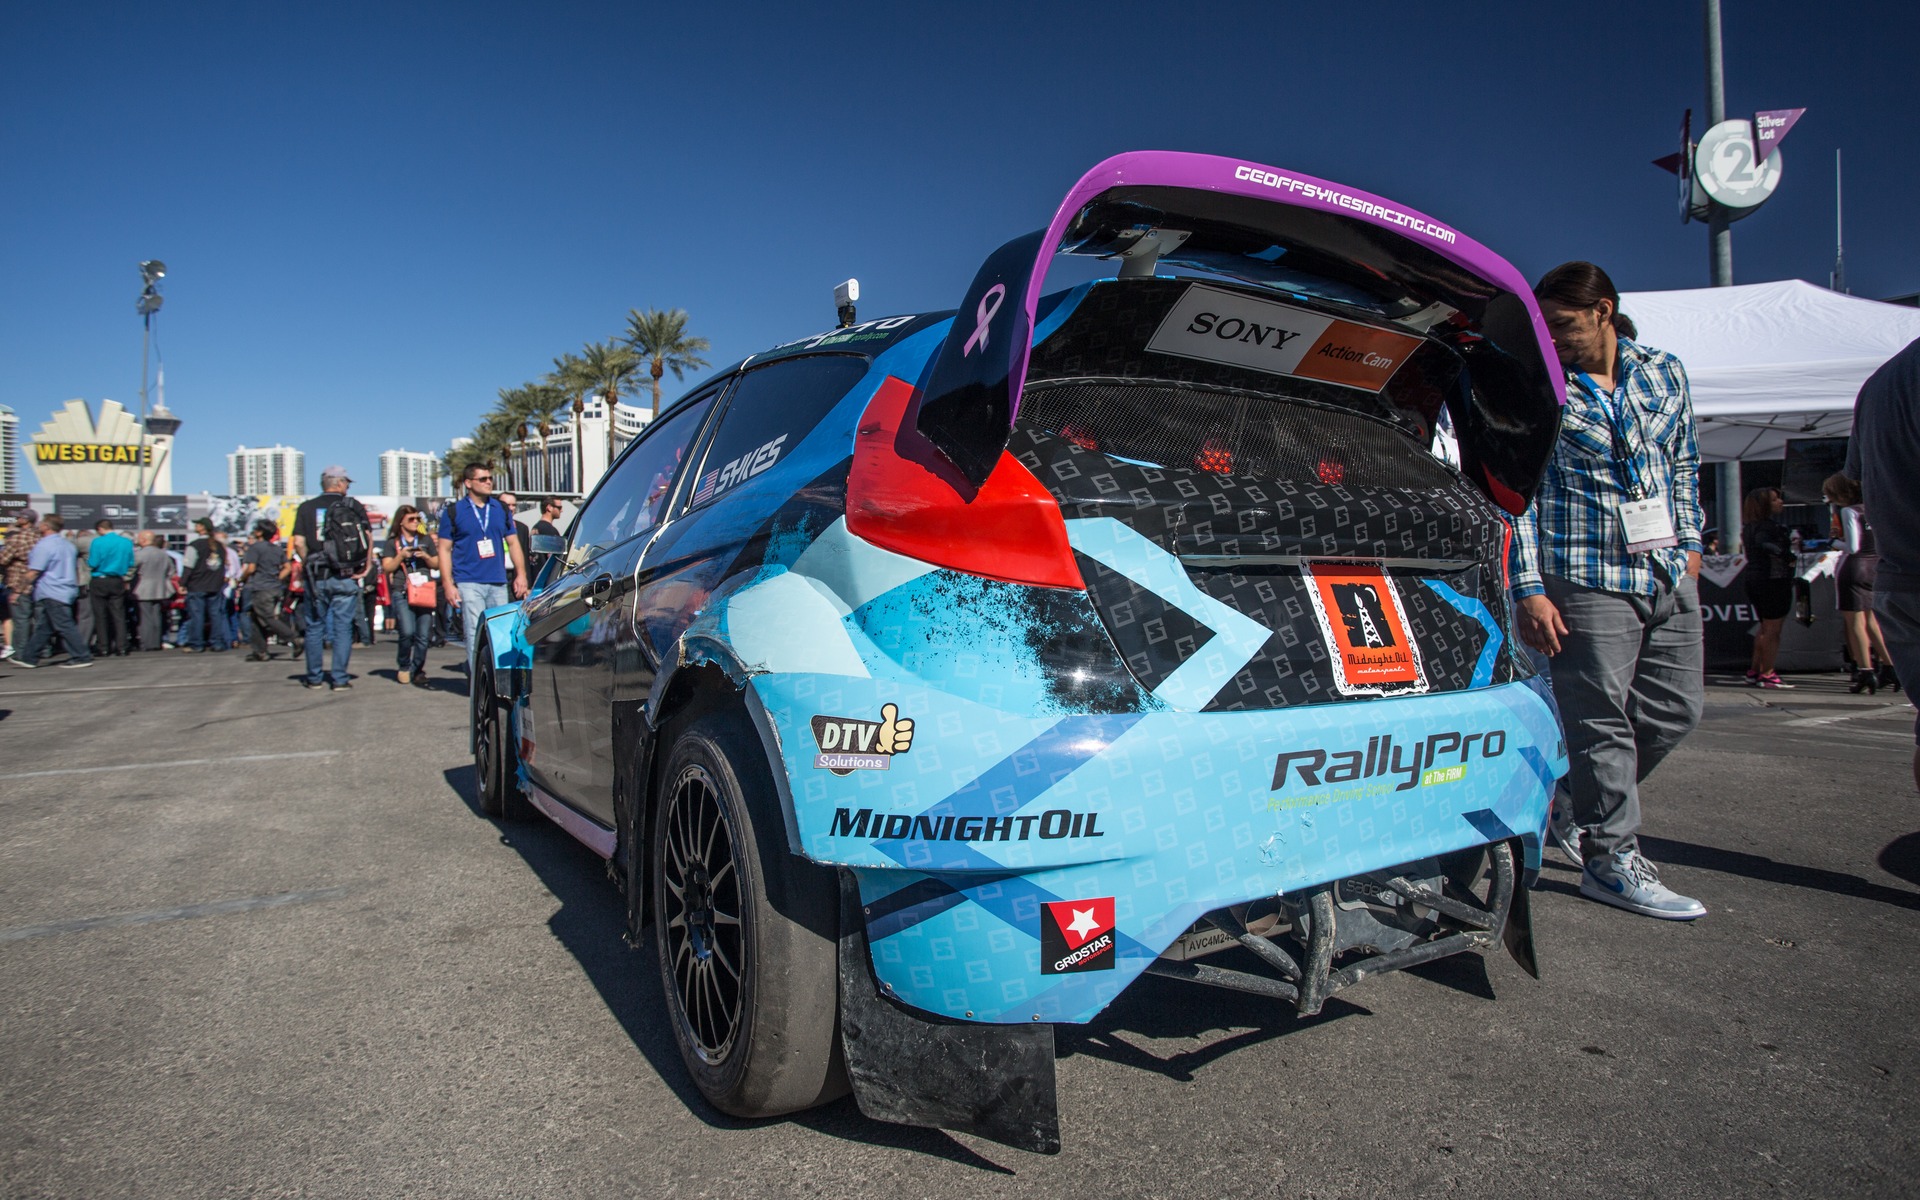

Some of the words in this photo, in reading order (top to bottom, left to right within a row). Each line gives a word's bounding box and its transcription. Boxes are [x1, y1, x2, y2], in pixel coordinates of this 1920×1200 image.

[1757, 116, 1786, 128] Silver
[1759, 129, 1775, 140] Lot
[1723, 142, 1754, 182] 2
[1235, 166, 1456, 244] GEOFFSYKESRACING.COM
[1186, 312, 1301, 350] SONY
[37, 443, 151, 464] WESTGATE
[714, 433, 788, 494] SYKES
[1347, 653, 1395, 666] Midnight
[1395, 652, 1409, 662] Oil
[822, 722, 877, 751] DTV
[819, 755, 883, 768] Solutions
[1271, 730, 1506, 791] RallyPro
[1424, 773, 1432, 784] at
[1433, 771, 1445, 783] The
[1446, 767, 1462, 780] FIRM
[1267, 793, 1330, 812] Performance
[1054, 935, 1112, 971] GRIDSTAR
[1078, 943, 1114, 966] MOTORSPORT
